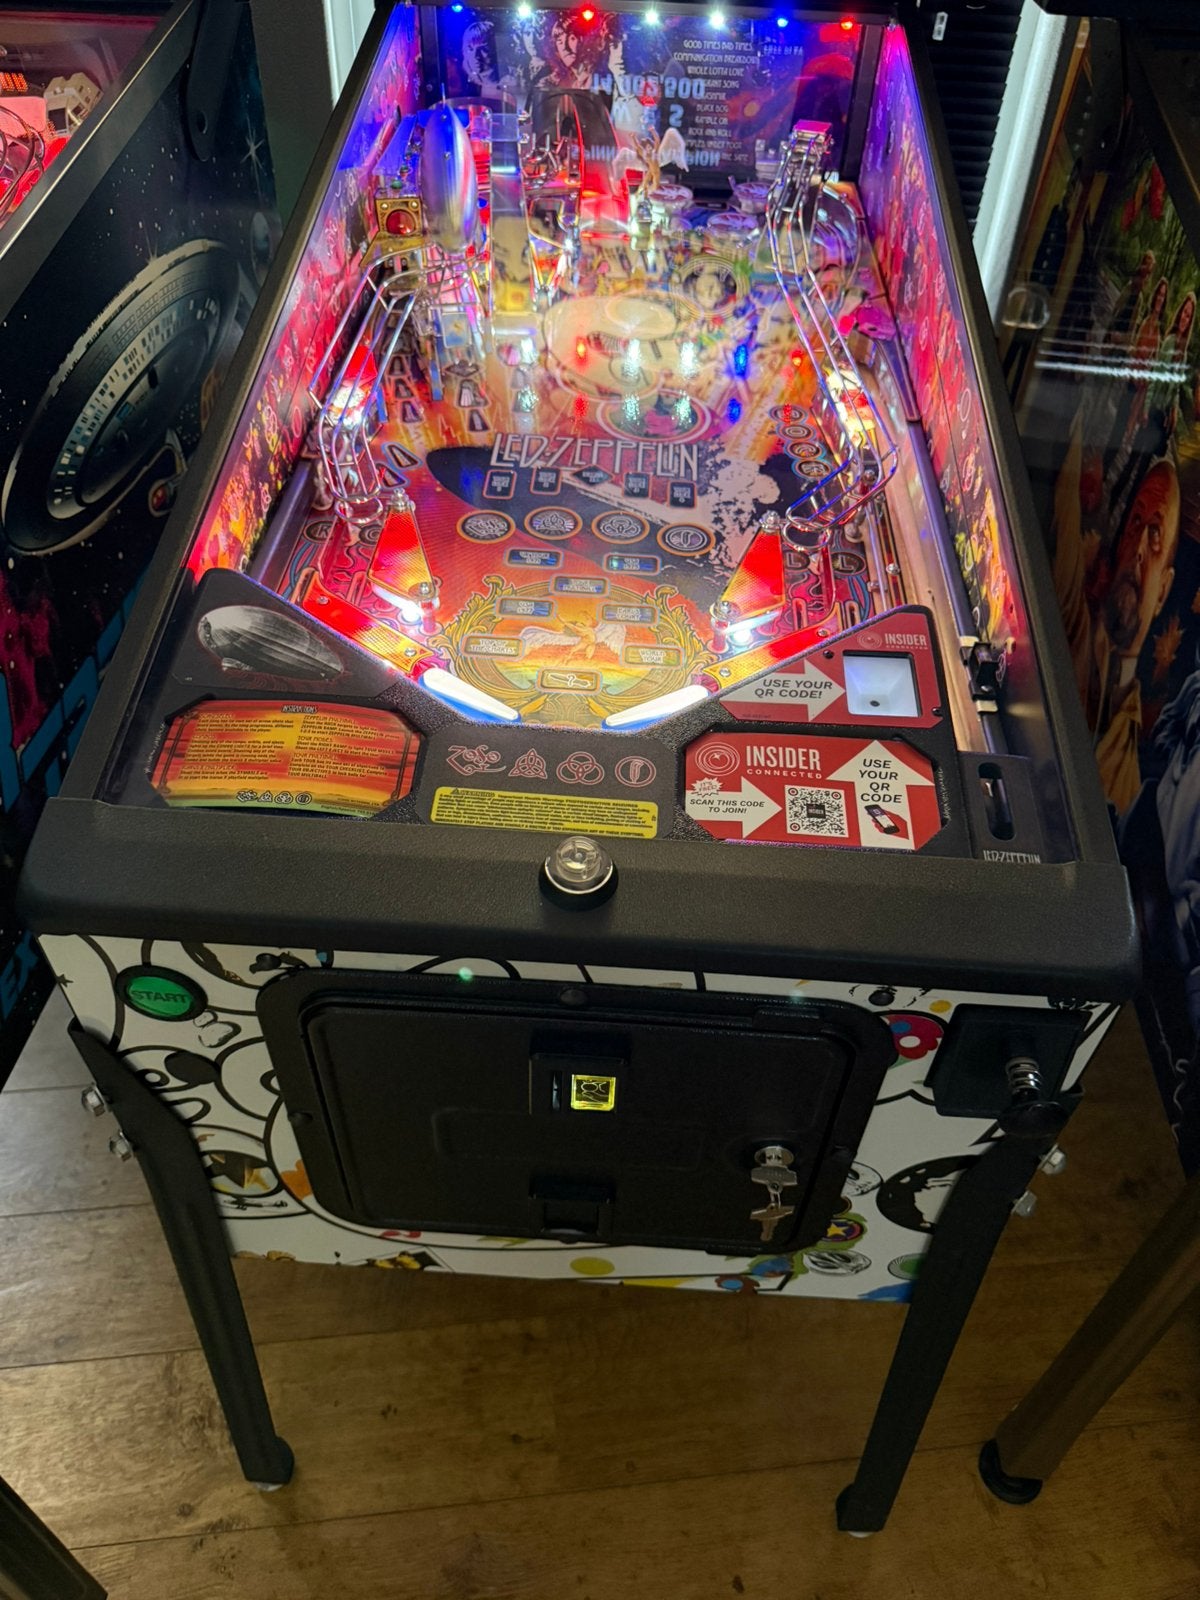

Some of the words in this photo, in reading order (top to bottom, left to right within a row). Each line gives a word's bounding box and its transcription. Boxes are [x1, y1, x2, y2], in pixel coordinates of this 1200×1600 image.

[684, 40, 702, 48] GOOD
[885, 633, 926, 646] INSIDER
[763, 679, 790, 688] USE
[796, 680, 832, 690] YOUR
[754, 688, 774, 698] QR
[779, 690, 822, 699] CODE!
[746, 746, 821, 770] INSIDER
[863, 758, 891, 769] USE
[747, 769, 822, 779] CONNECTED
[859, 770, 898, 780] YOUR
[870, 782, 890, 792] QR
[860, 793, 902, 803] CODE
[131, 990, 188, 1003] START
